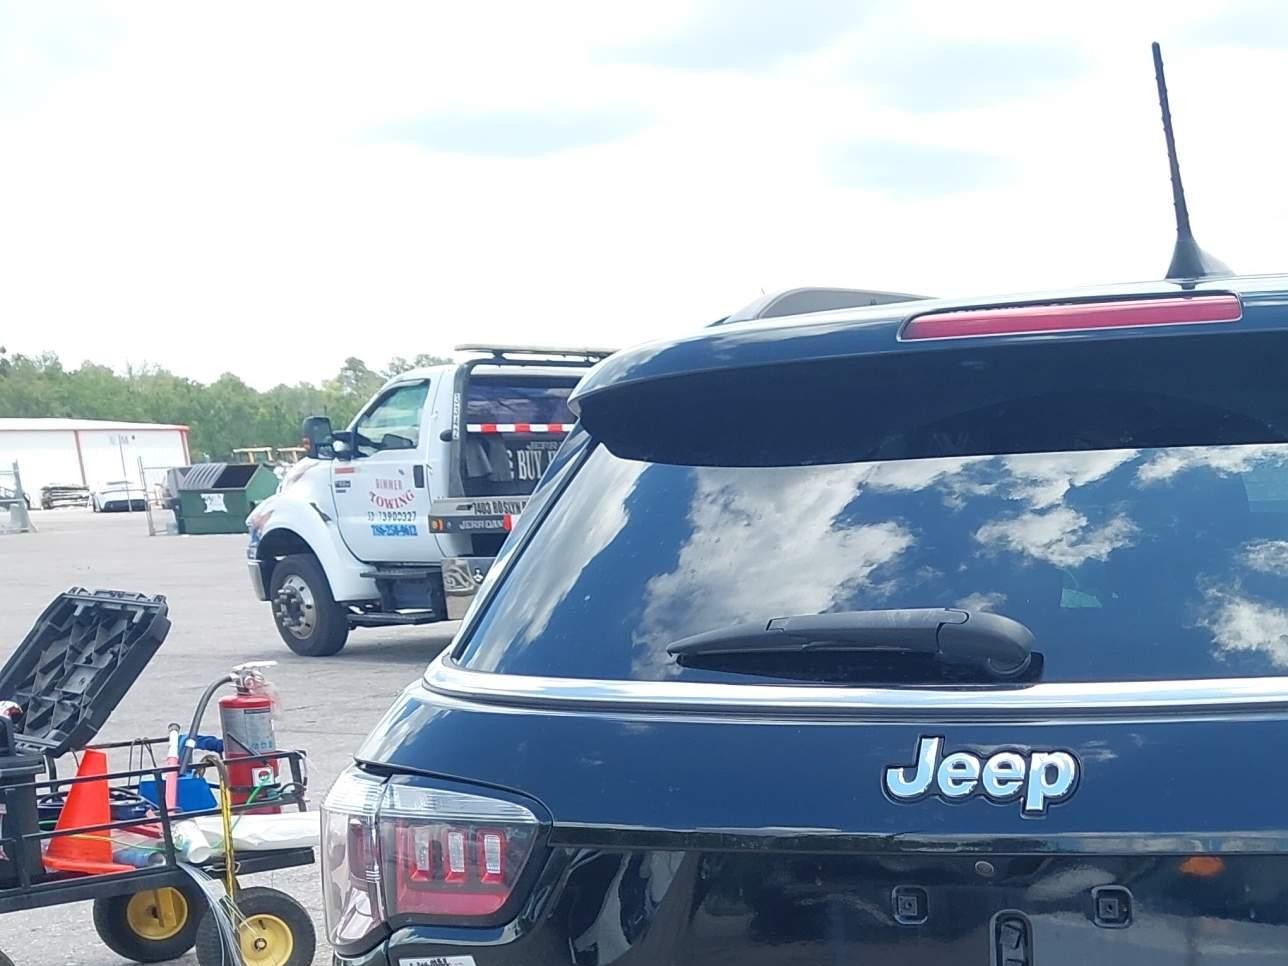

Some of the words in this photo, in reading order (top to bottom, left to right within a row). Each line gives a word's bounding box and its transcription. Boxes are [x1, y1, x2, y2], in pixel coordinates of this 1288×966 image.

[516, 449, 542, 481] BUY
[368, 489, 415, 509] TOWING
[884, 735, 1079, 814] Jeep
